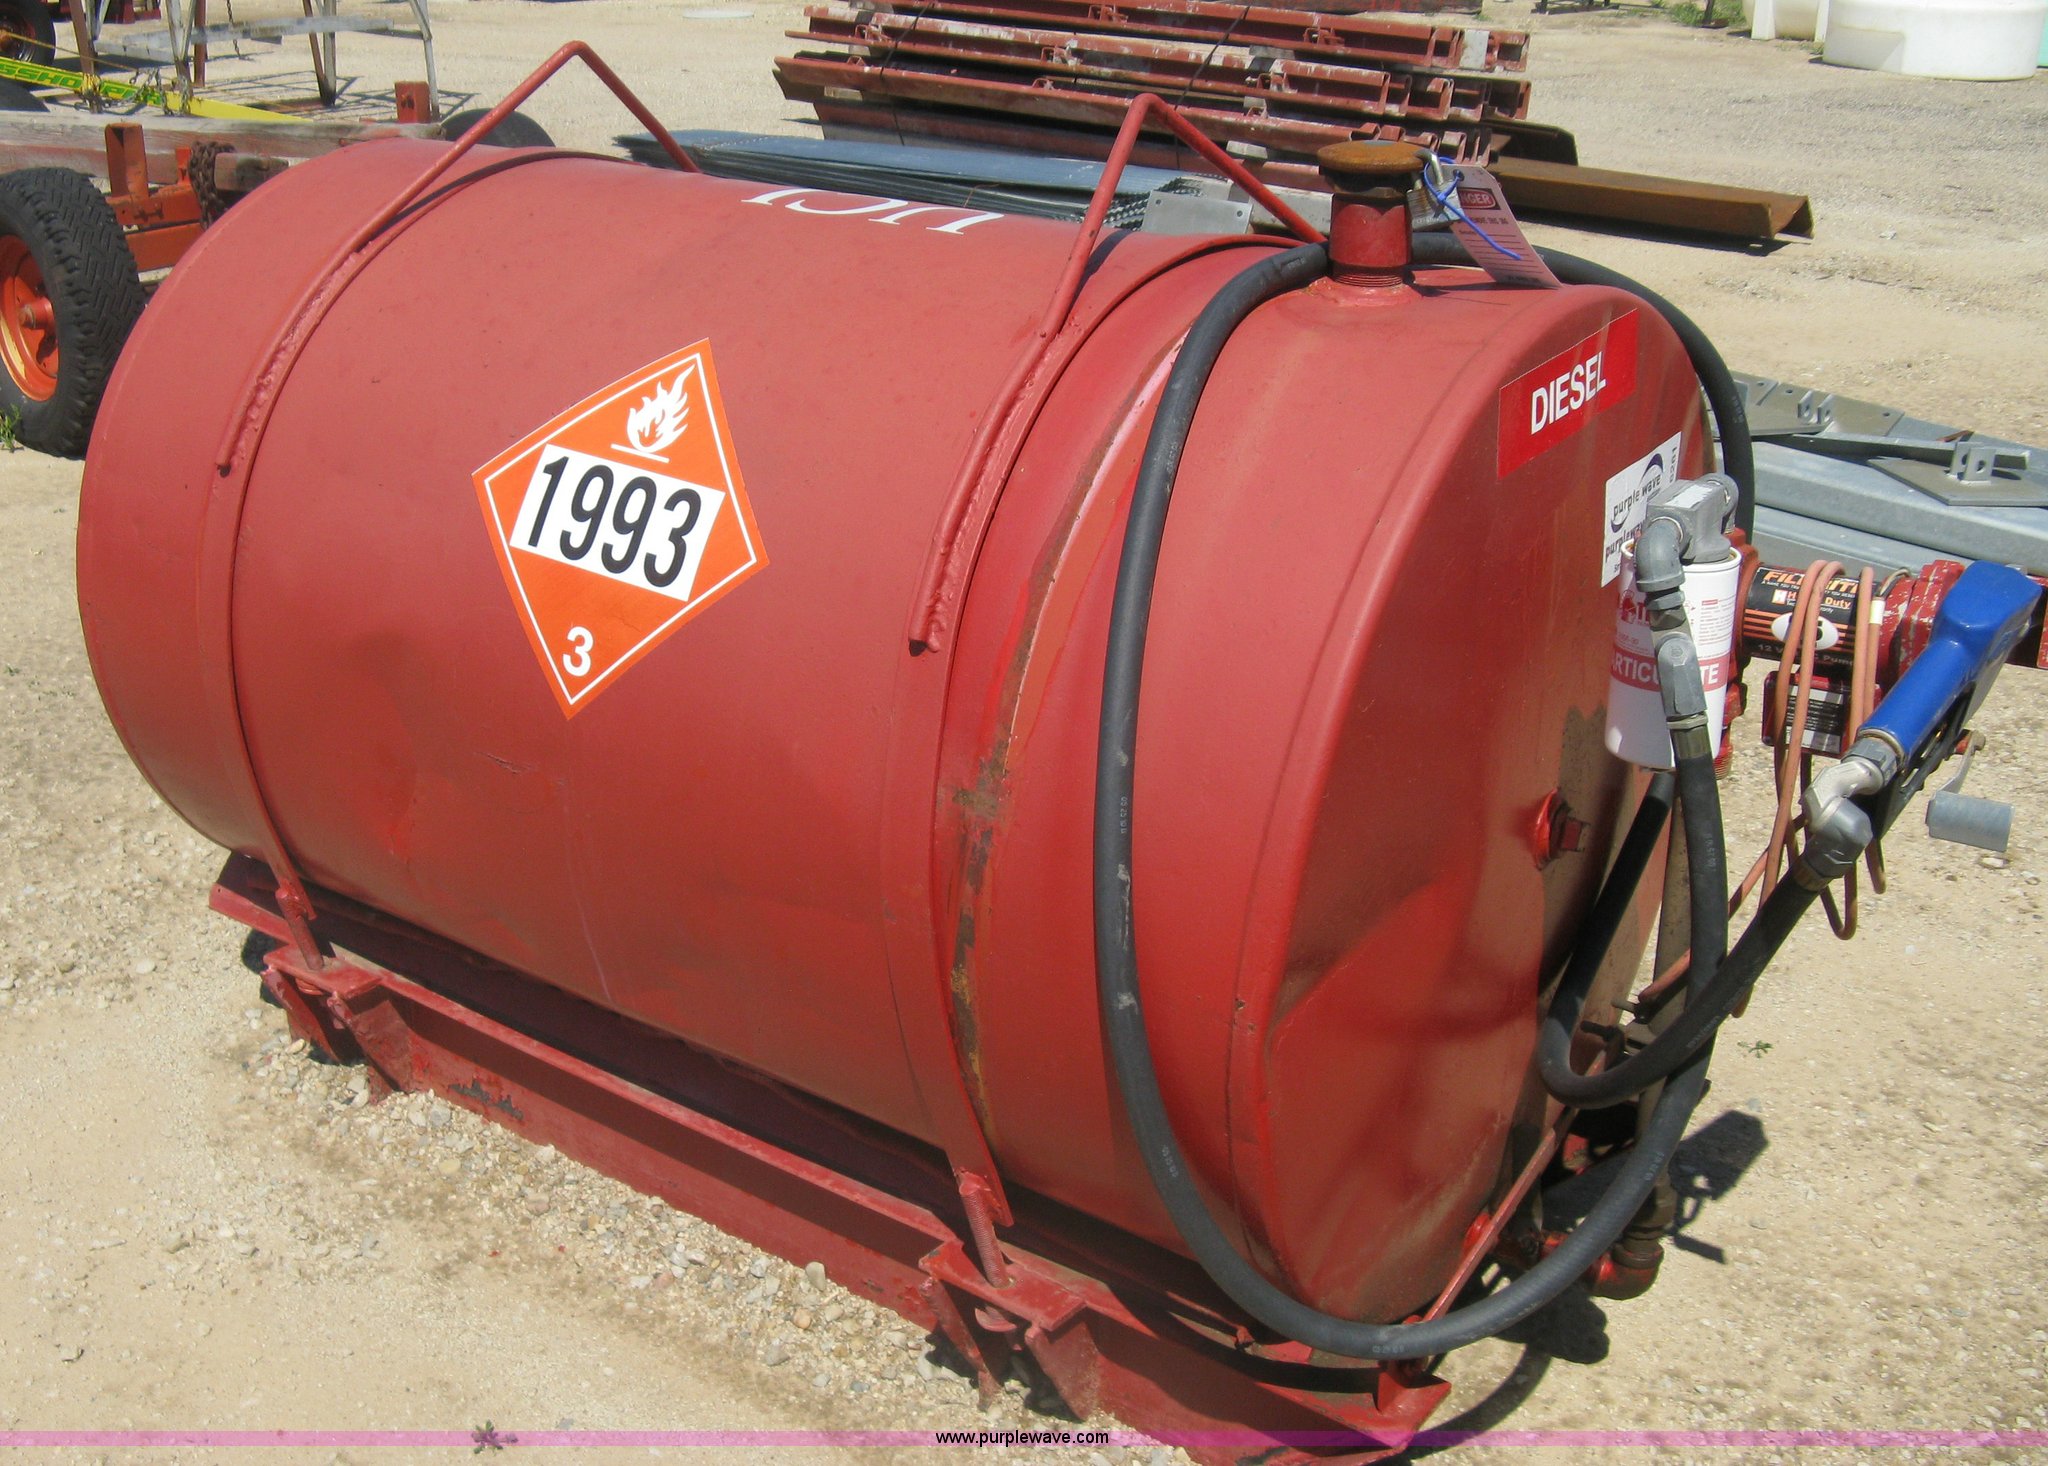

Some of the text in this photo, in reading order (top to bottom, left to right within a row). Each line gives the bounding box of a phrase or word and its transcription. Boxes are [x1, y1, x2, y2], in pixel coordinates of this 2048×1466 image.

[1531, 351, 1606, 435] DIESEL
[527, 456, 702, 588] 1993
[1613, 489, 1641, 521] purple
[1641, 474, 1662, 497] wave
[1825, 597, 1851, 609] Duty
[562, 625, 594, 677] 3
